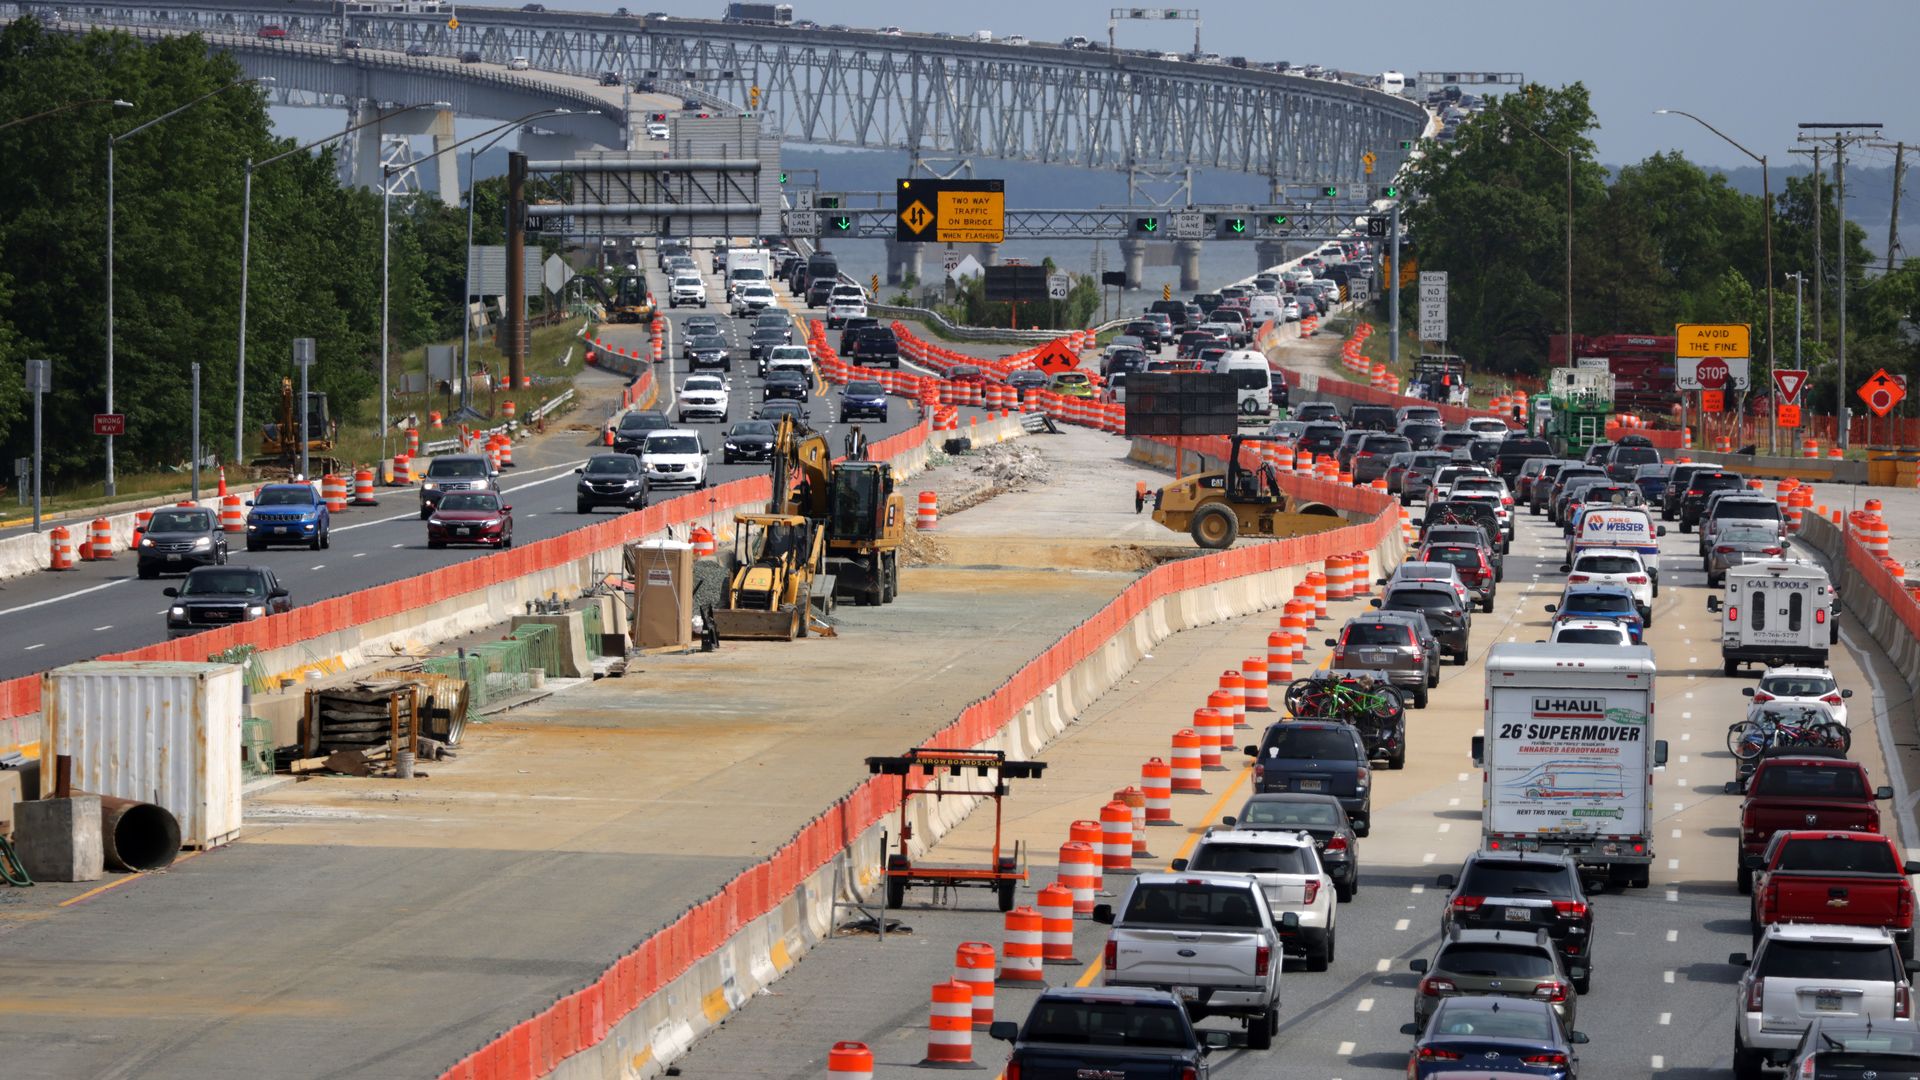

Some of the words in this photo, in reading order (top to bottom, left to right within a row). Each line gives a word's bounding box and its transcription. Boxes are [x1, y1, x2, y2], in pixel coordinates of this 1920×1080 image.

[528, 216, 540, 228] N1
[964, 218, 993, 226] BRIDGE
[1371, 221, 1383, 232] S1
[1051, 288, 1066, 297] 40
[1353, 291, 1367, 299] 40
[1427, 288, 1440, 296] NO
[1697, 330, 1730, 338] AVOID
[1689, 343, 1709, 351] THE
[1714, 343, 1738, 351] FINE
[1698, 366, 1728, 380] STOP
[1211, 479, 1224, 487] CAT
[1606, 523, 1644, 532] WEBSTER
[1747, 580, 1768, 588] CAL
[1773, 581, 1809, 590] POOLS
[1535, 699, 1603, 713] U-HAUL
[1500, 723, 1528, 740] 26'
[1528, 724, 1641, 742] SUPERMOVER
[1519, 745, 1560, 753] ENHANCED
[1560, 747, 1619, 755] AERODYNAMICS
[915, 758, 1003, 767] ARROWBOARDS.COM
[1516, 808, 1532, 816] RENT
[1547, 809, 1568, 817] TRUCK!
[1076, 1068, 1125, 1080] GMC
